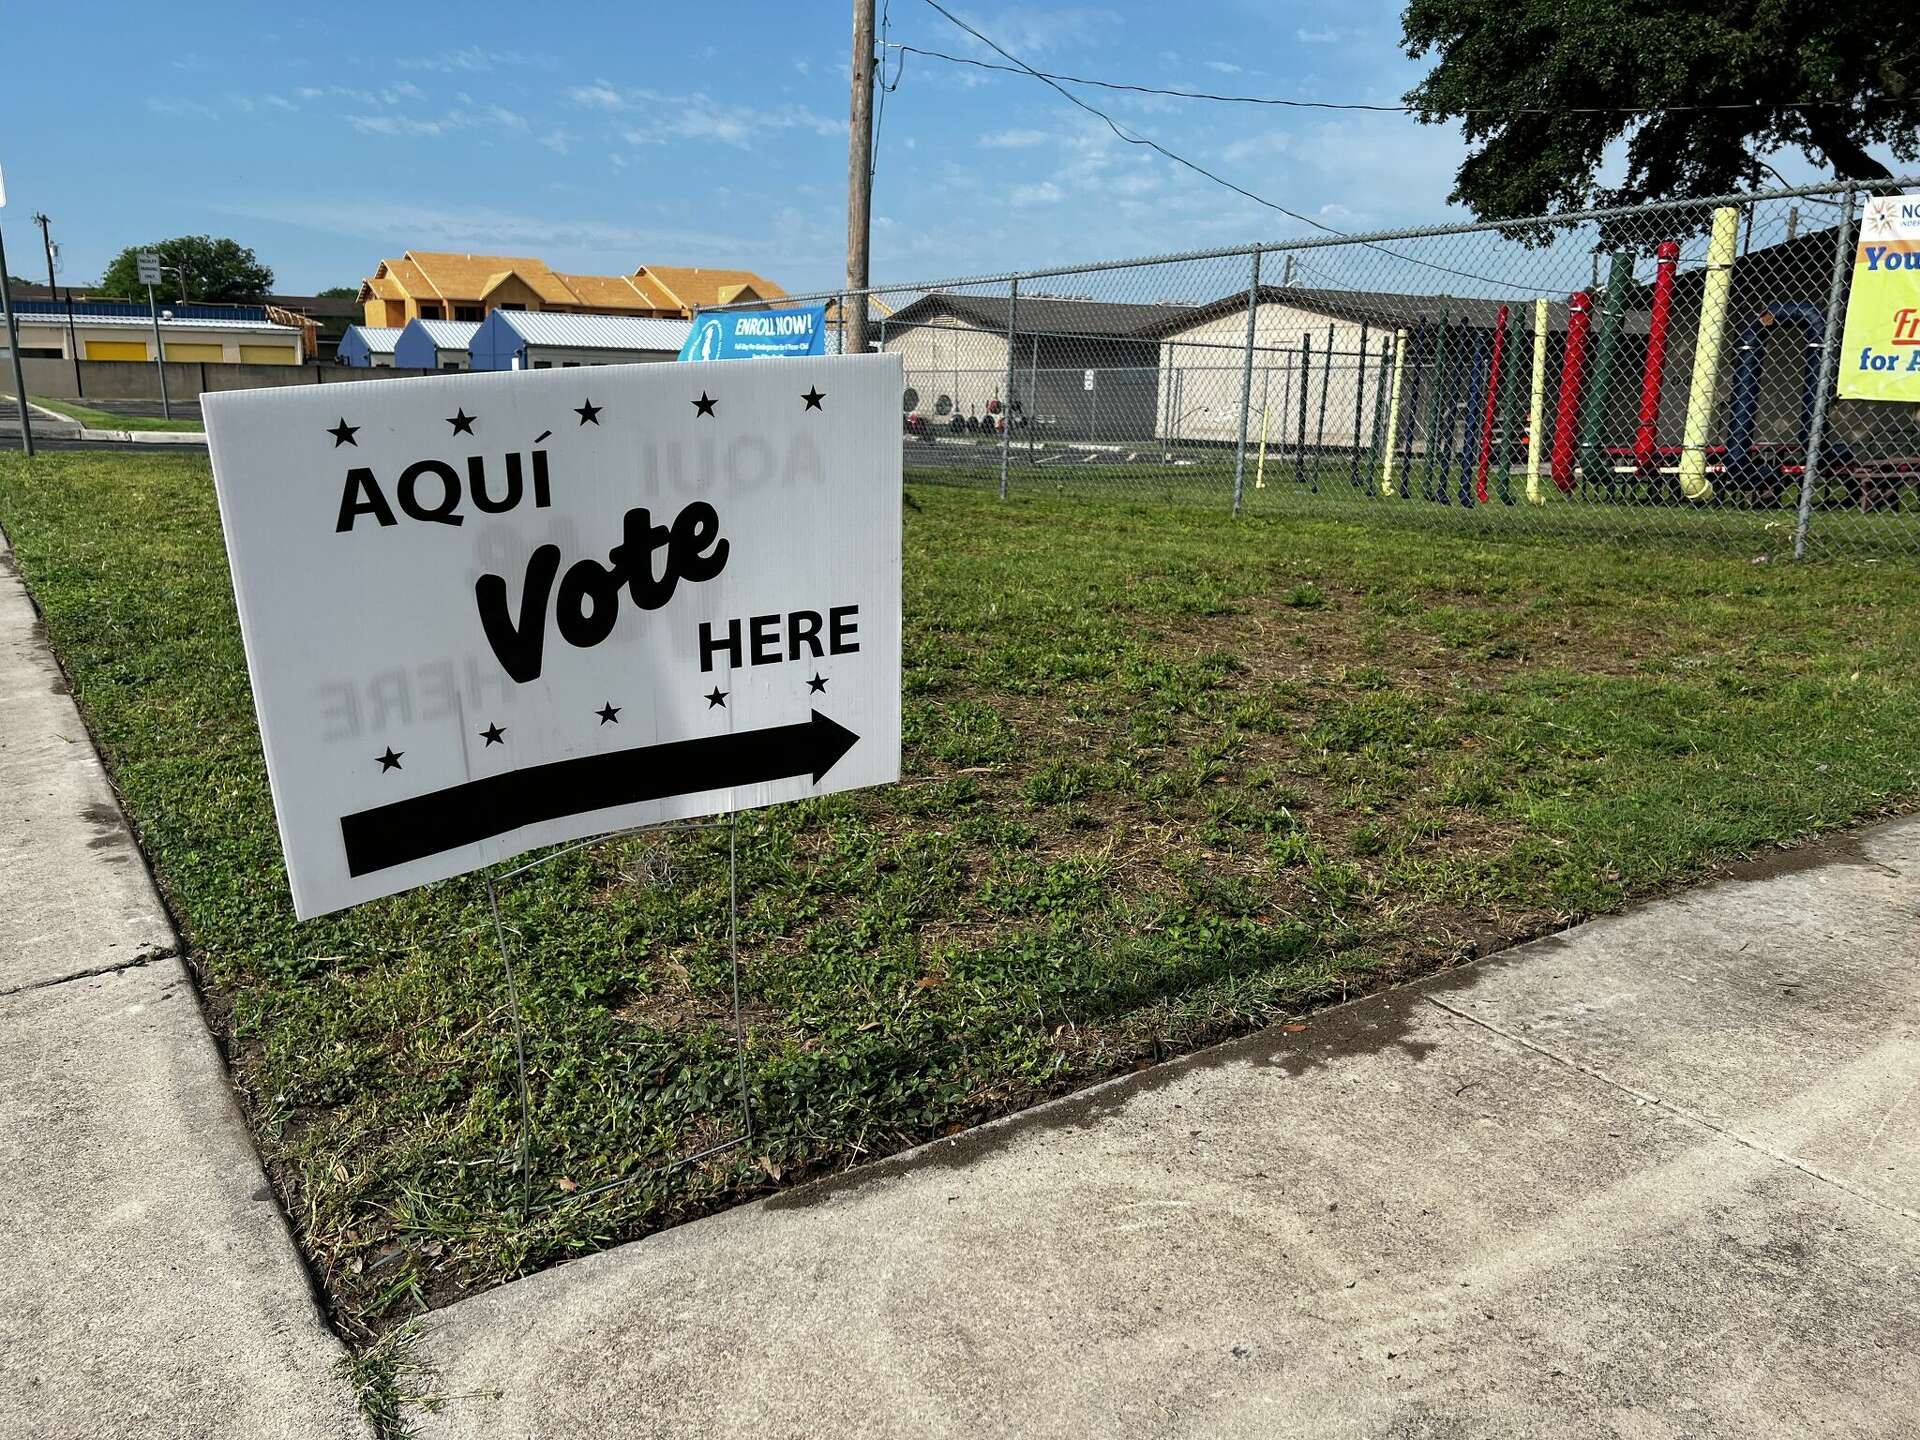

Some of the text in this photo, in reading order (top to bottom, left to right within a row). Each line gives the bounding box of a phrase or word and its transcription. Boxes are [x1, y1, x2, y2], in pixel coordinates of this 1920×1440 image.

[735, 314, 813, 335] ENROLL NOW!
[1859, 347, 1900, 371] for
[336, 431, 553, 532] AQUÍ
[475, 502, 729, 683] Vote
[699, 605, 860, 672] HERE
